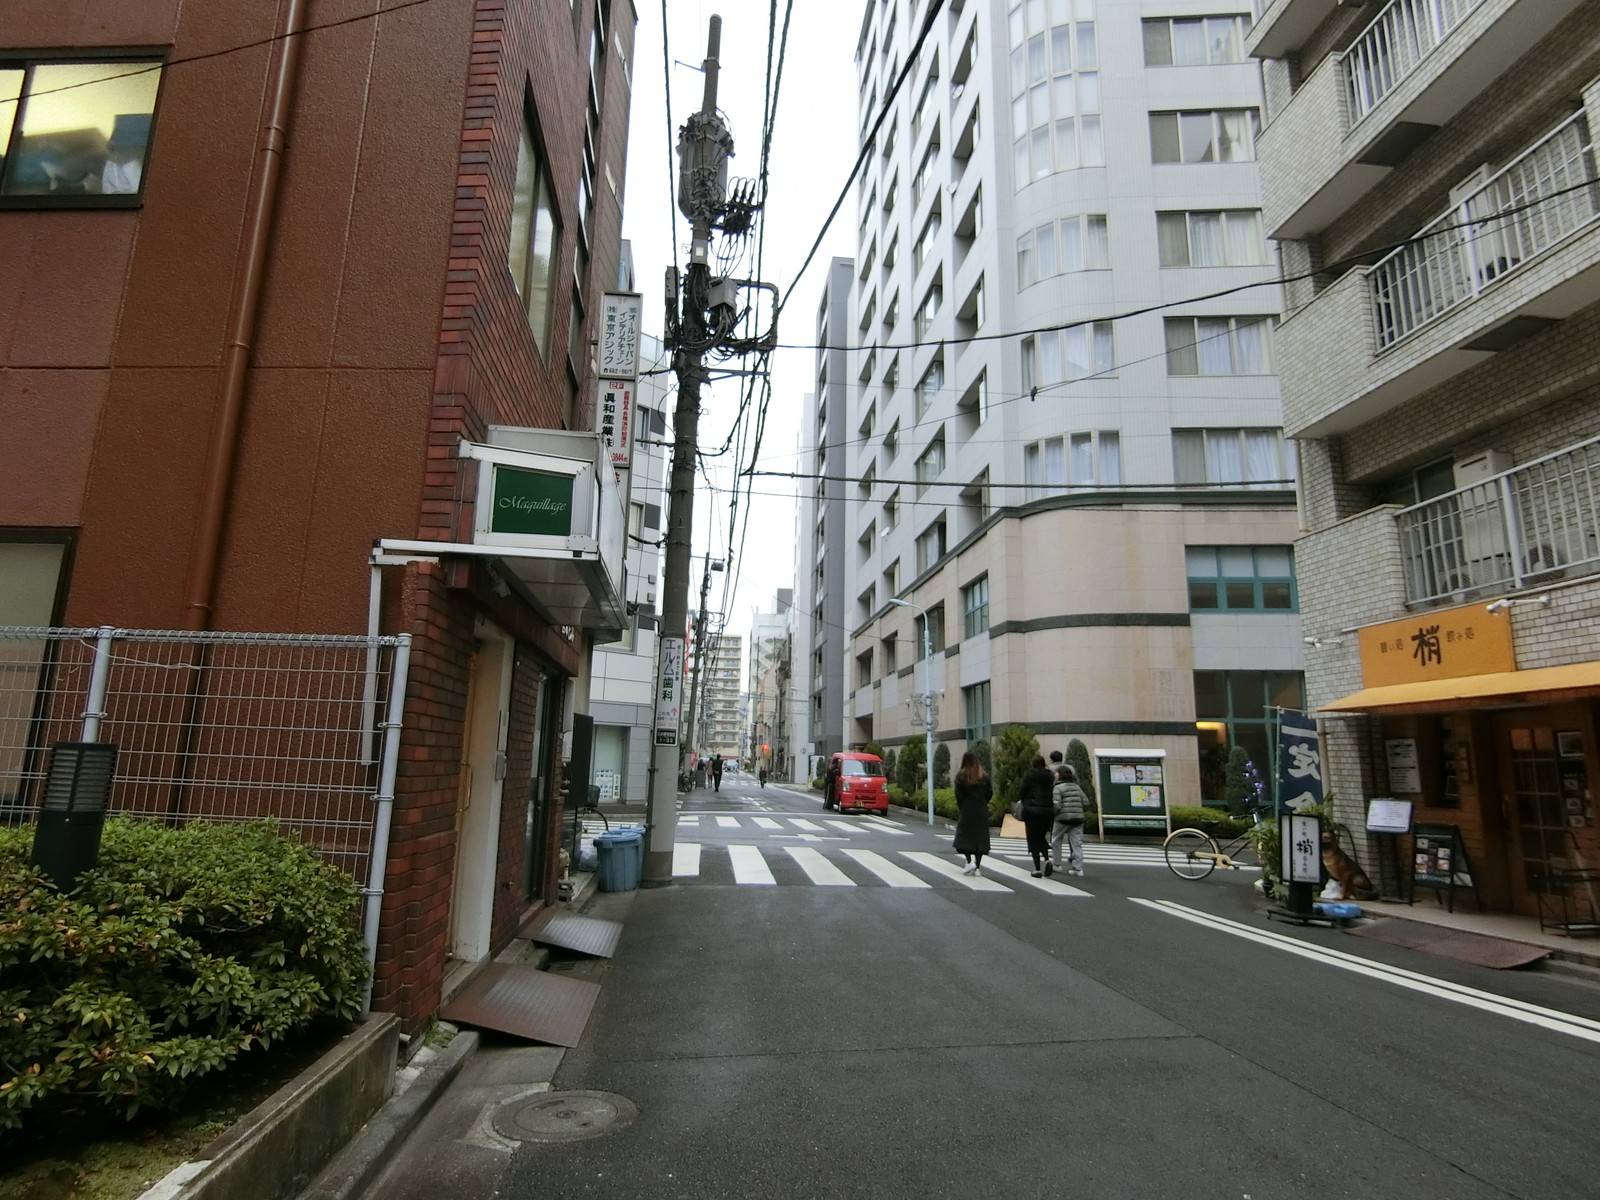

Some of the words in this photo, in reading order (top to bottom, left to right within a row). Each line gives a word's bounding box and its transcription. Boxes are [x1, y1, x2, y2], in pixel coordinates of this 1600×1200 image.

[499, 496, 567, 515] Maquillage
[1411, 625, 1442, 666] 梢
[662, 640, 676, 702] エルム歯科
